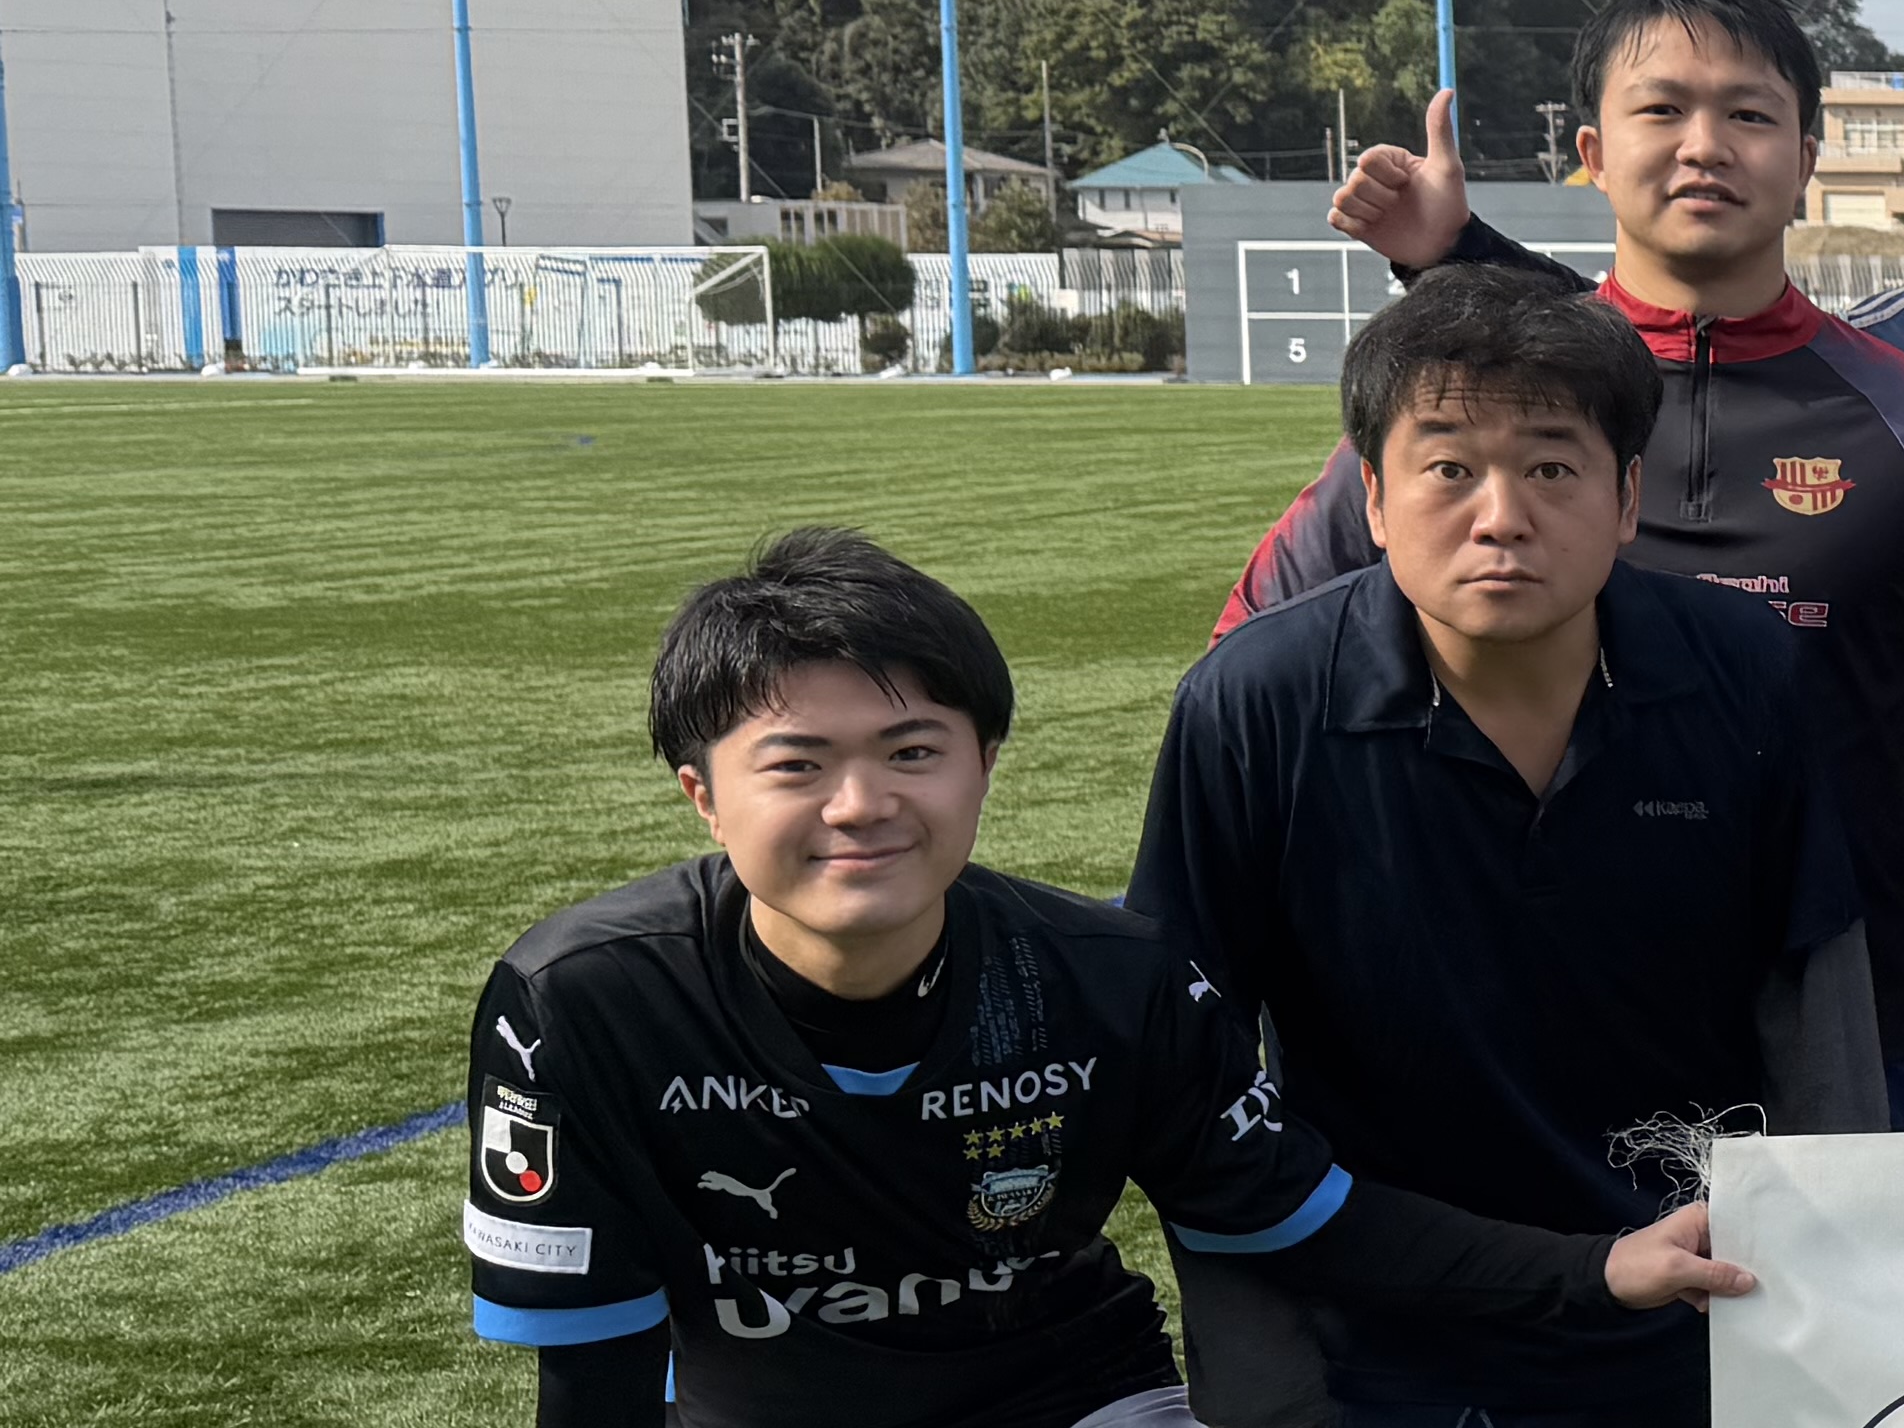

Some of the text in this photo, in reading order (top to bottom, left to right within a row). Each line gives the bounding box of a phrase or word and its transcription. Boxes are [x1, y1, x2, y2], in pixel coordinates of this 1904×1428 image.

[1285, 268, 1301, 295] 1
[1288, 337, 1308, 364] 5
[920, 1057, 1098, 1121] RENOSY
[535, 1242, 578, 1258] CITY
